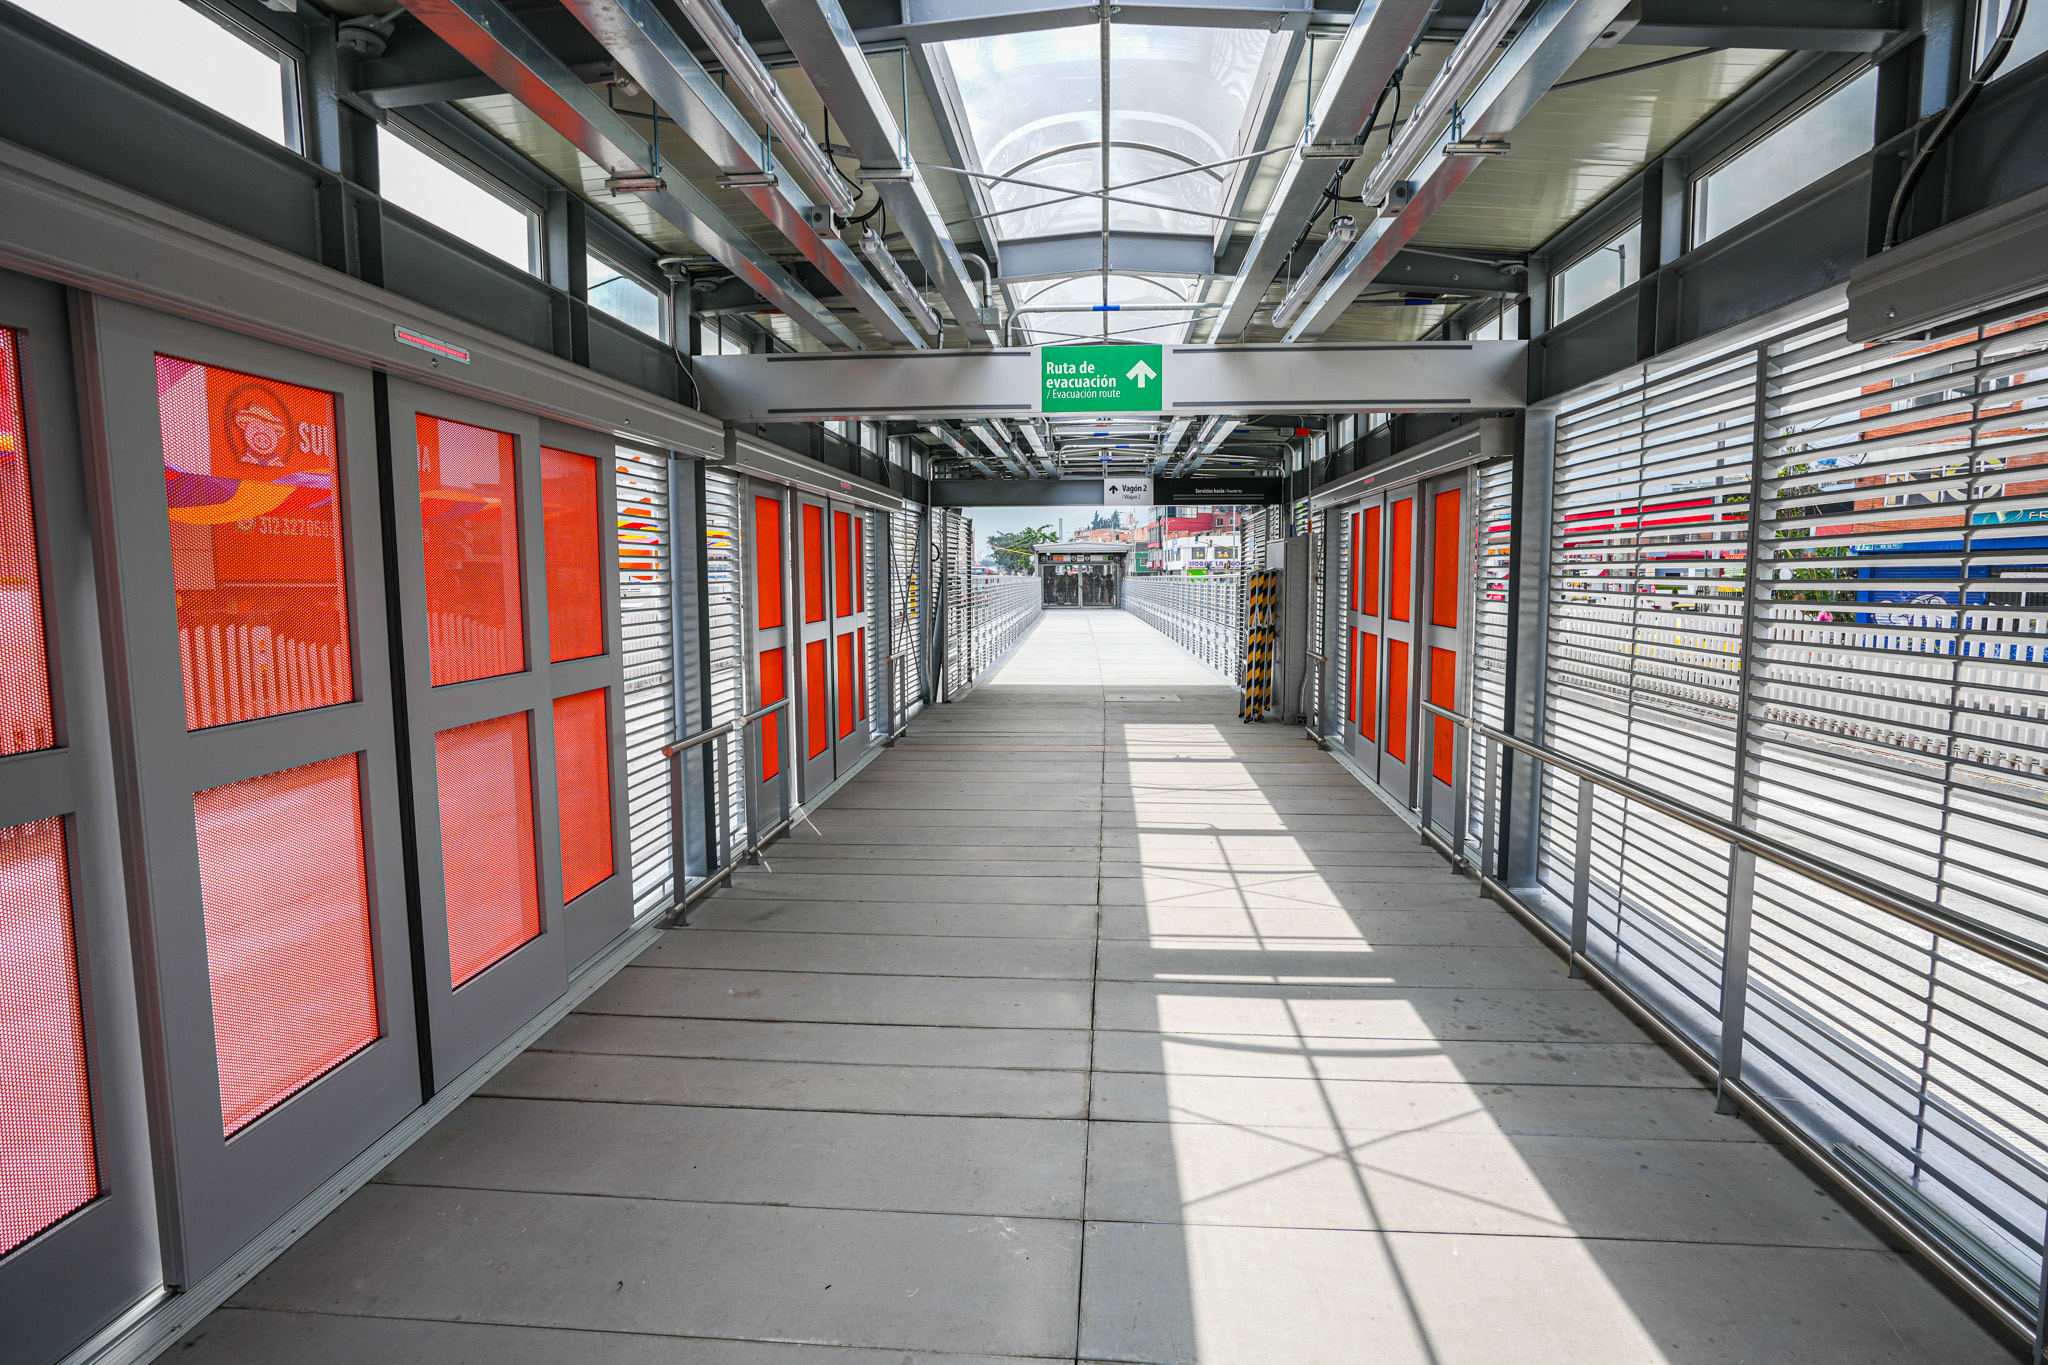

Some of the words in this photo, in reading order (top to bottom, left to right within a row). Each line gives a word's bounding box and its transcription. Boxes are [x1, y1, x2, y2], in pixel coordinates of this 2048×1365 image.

[1046, 362, 1076, 375] Ruta
[1079, 361, 1095, 374] de
[1046, 374, 1117, 388] evacuación
[1052, 389, 1097, 399] Evacuación
[1099, 389, 1121, 398] route
[1121, 484, 1142, 493] Vagón
